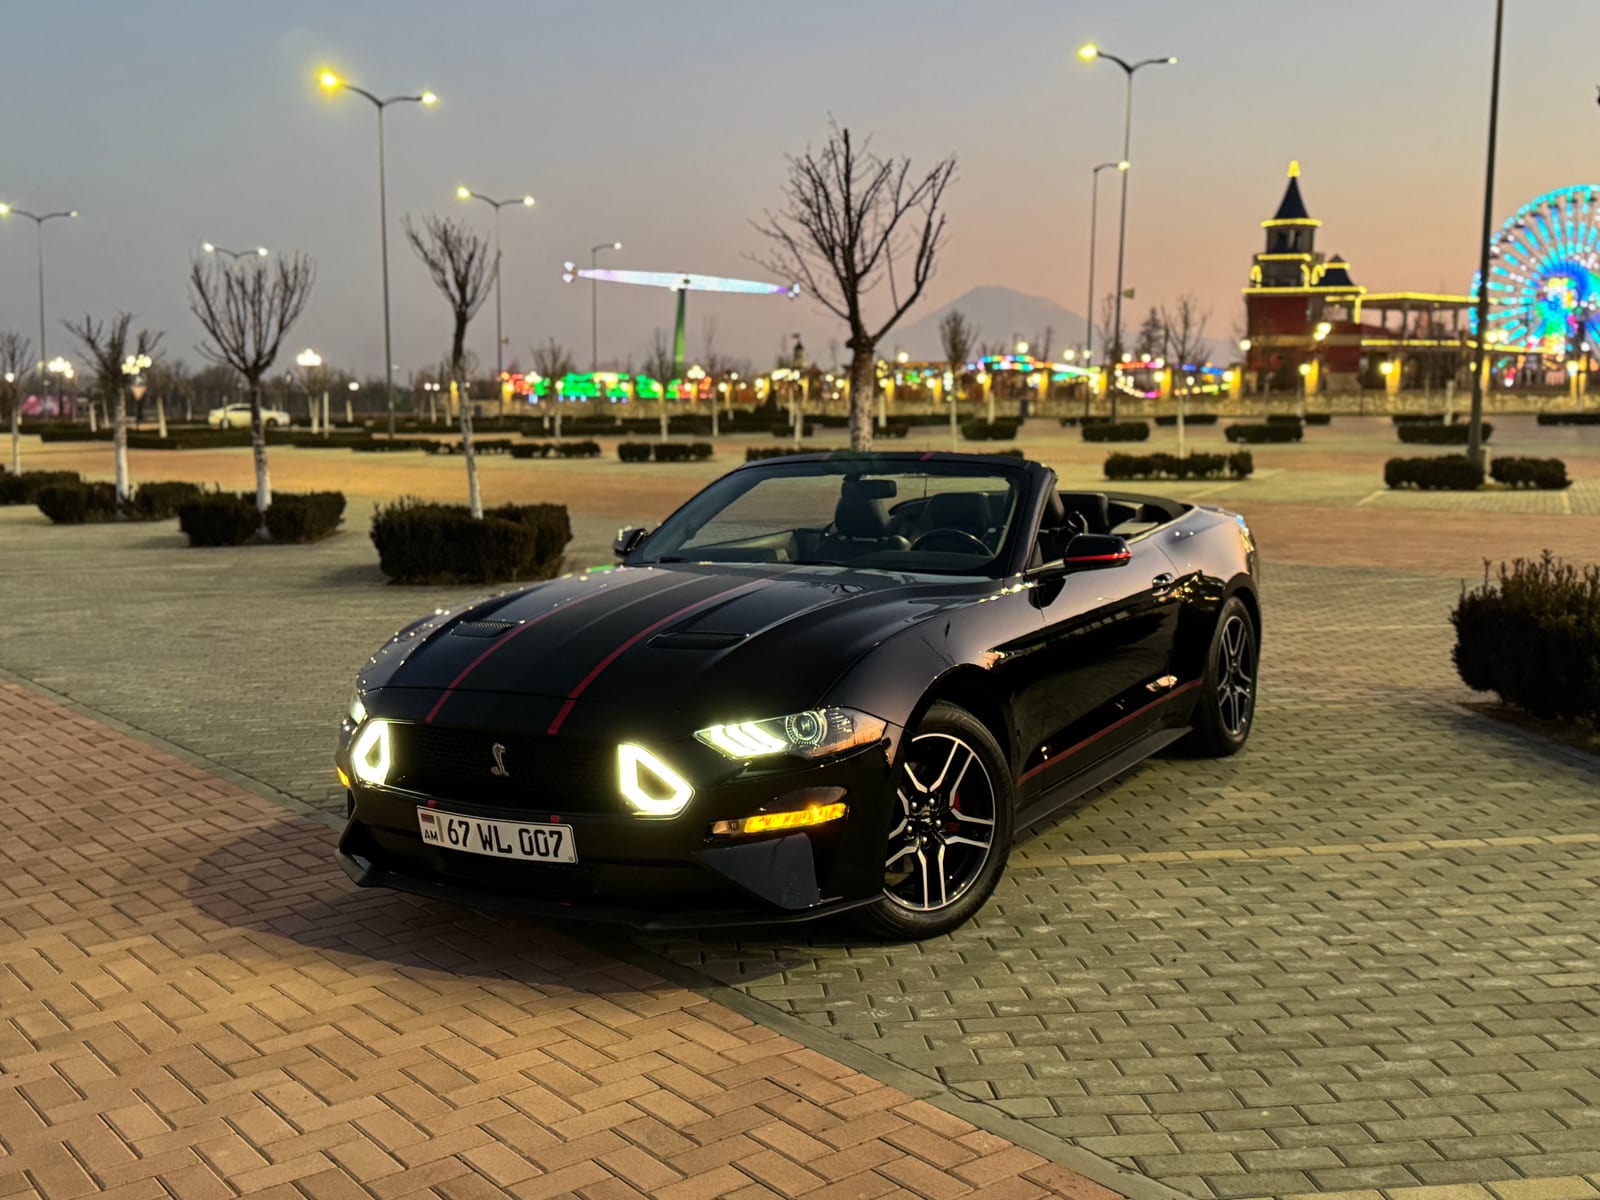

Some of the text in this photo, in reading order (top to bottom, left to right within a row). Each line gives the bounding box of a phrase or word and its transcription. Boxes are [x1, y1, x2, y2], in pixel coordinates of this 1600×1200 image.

[424, 829, 439, 842] AM
[447, 819, 563, 858] 67 WL 007
